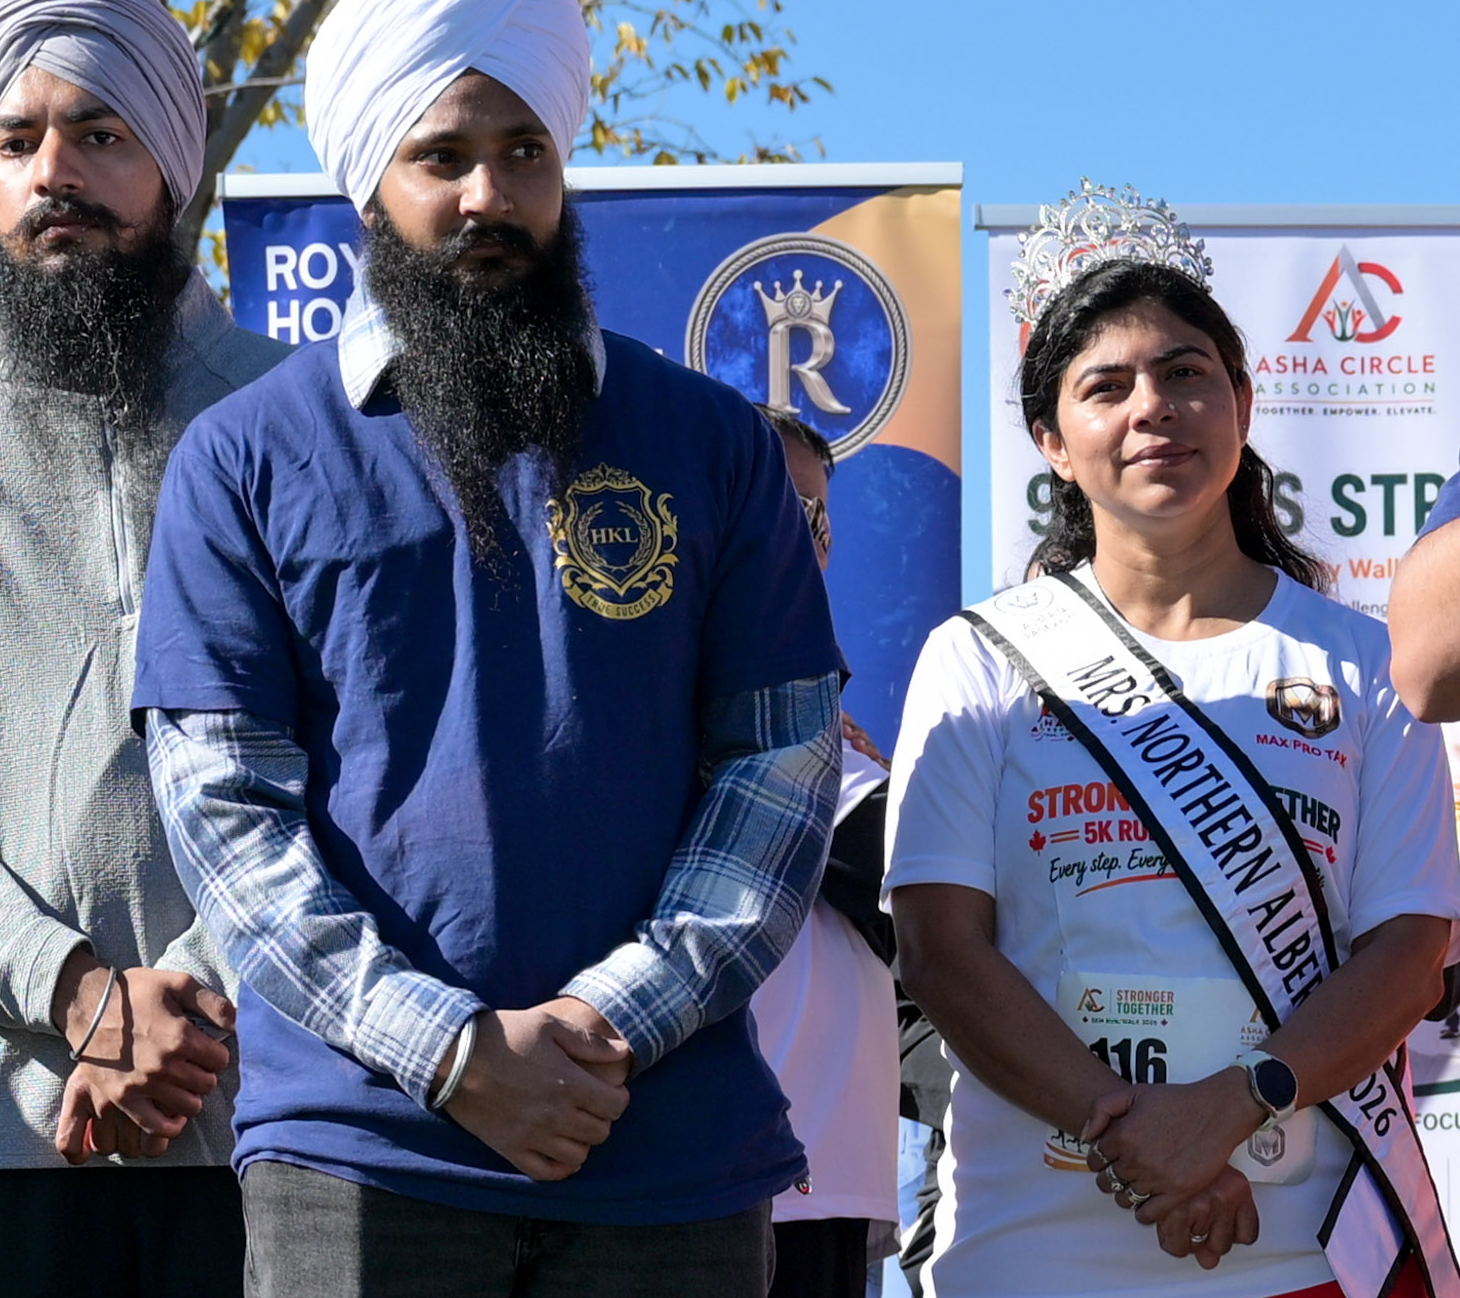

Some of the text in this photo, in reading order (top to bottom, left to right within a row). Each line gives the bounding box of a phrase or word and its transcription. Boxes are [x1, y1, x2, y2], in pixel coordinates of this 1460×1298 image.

[1255, 355, 1436, 375] ASHA CIRCLE
[1255, 382, 1436, 396] ASSOCIATION
[1256, 406, 1436, 417] TOGETHER. EMPOWER. ELEVATE.
[591, 527, 639, 545] HKL
[615, 593, 656, 617] SUCCESS
[1066, 655, 1151, 725] MRS.
[1121, 714, 1281, 896] NORTHERN
[1084, 819, 1155, 844] 5K RU
[1049, 848, 1171, 886] Every step. Every
[1116, 989, 1175, 1003] STRONGER
[1116, 1002, 1174, 1016] TOGETHER
[1089, 1037, 1168, 1085] 116
